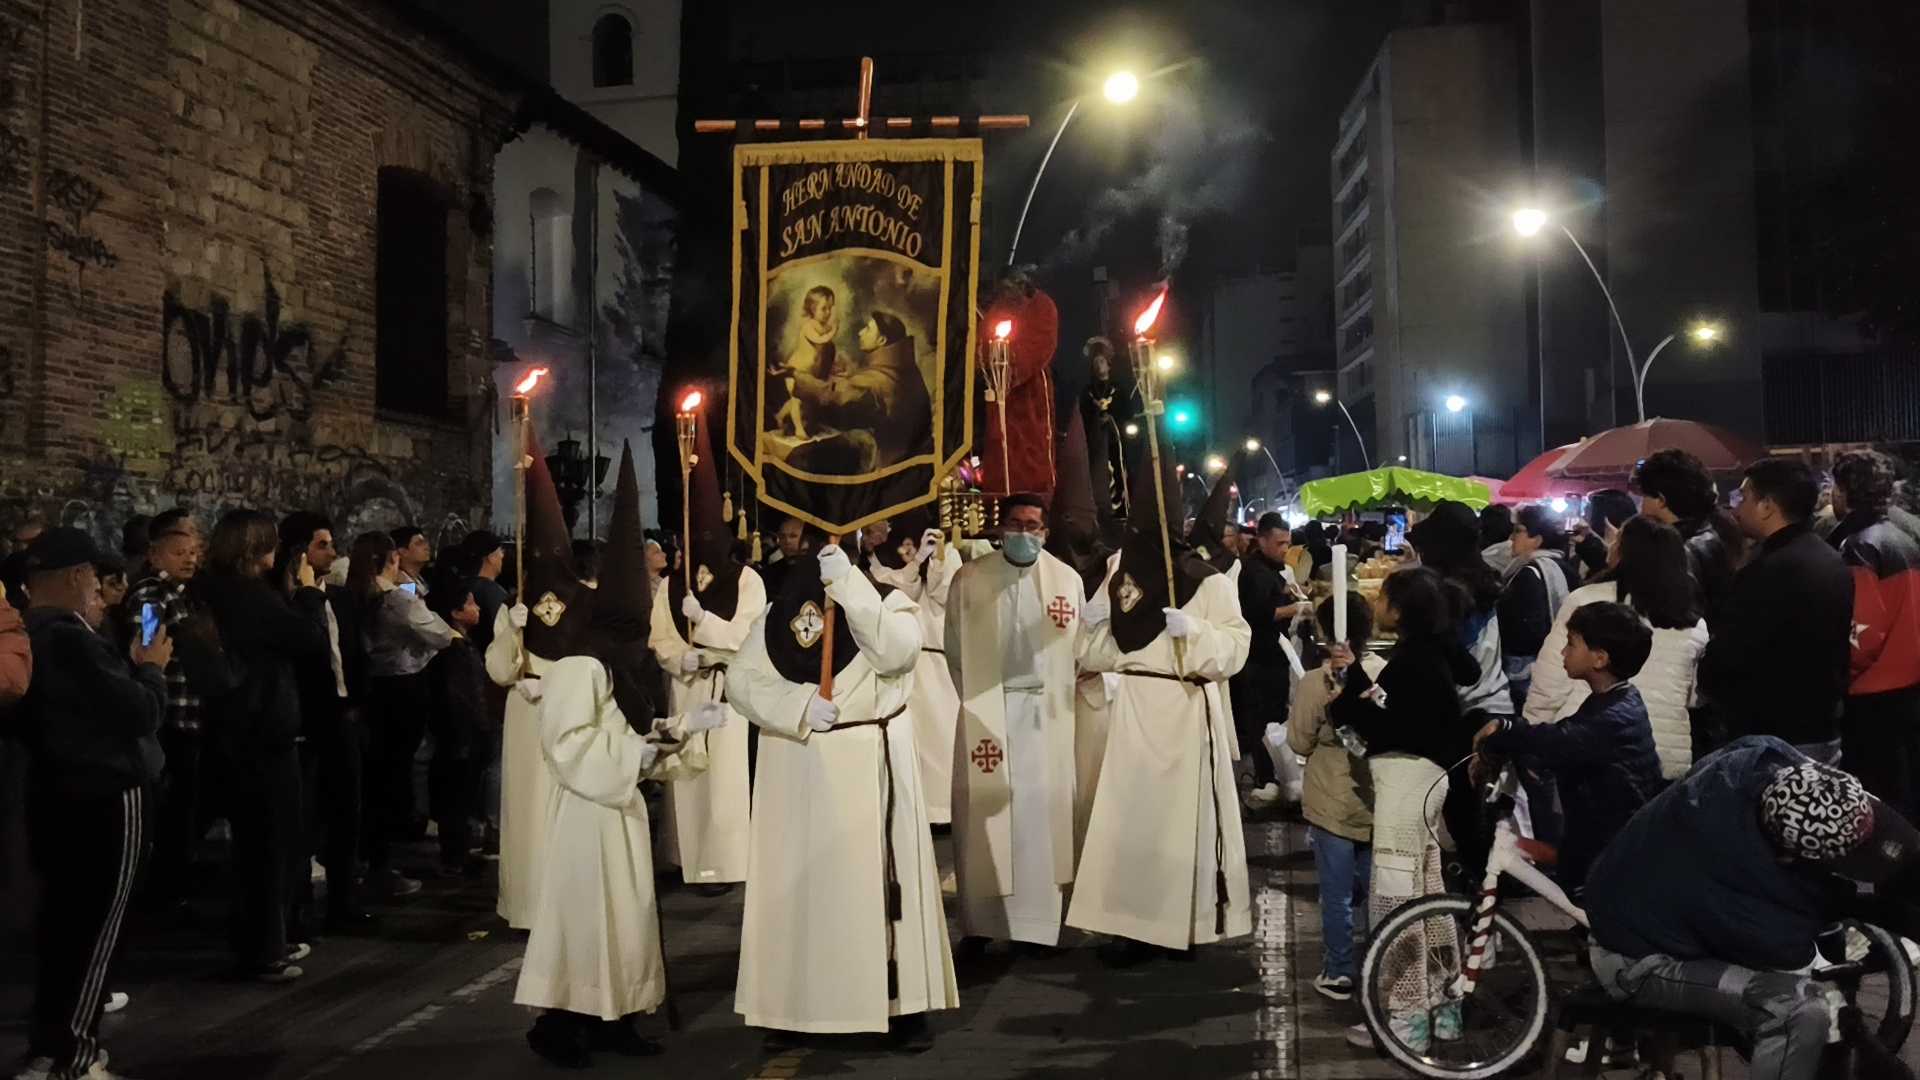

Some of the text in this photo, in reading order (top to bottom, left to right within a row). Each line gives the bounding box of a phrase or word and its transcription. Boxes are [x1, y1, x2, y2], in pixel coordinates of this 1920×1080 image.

[784, 163, 923, 221] HERMANDAD DE
[781, 203, 922, 258] SAN ANTONIO
